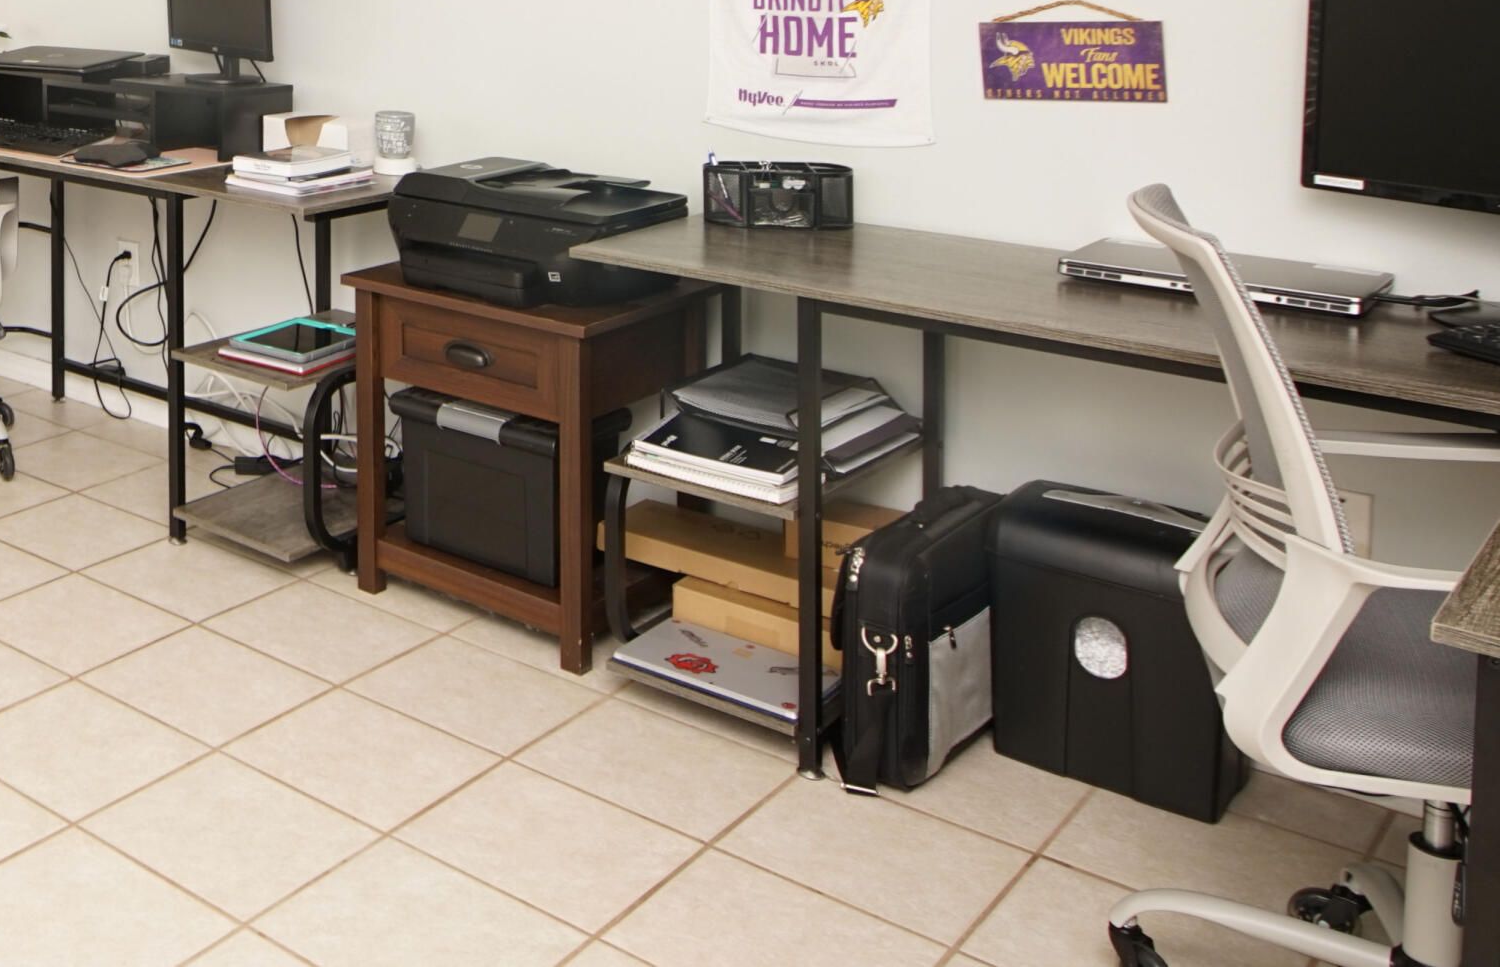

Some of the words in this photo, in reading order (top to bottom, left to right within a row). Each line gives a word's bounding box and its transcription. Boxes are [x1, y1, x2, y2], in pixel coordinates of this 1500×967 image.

[759, 14, 857, 58] HOME
[1060, 27, 1136, 46] VIKINGS
[1080, 47, 1118, 63] Fans
[1041, 62, 1162, 90] WELCOME
[738, 88, 784, 107] HyVee
[1053, 89, 1080, 99] NOT
